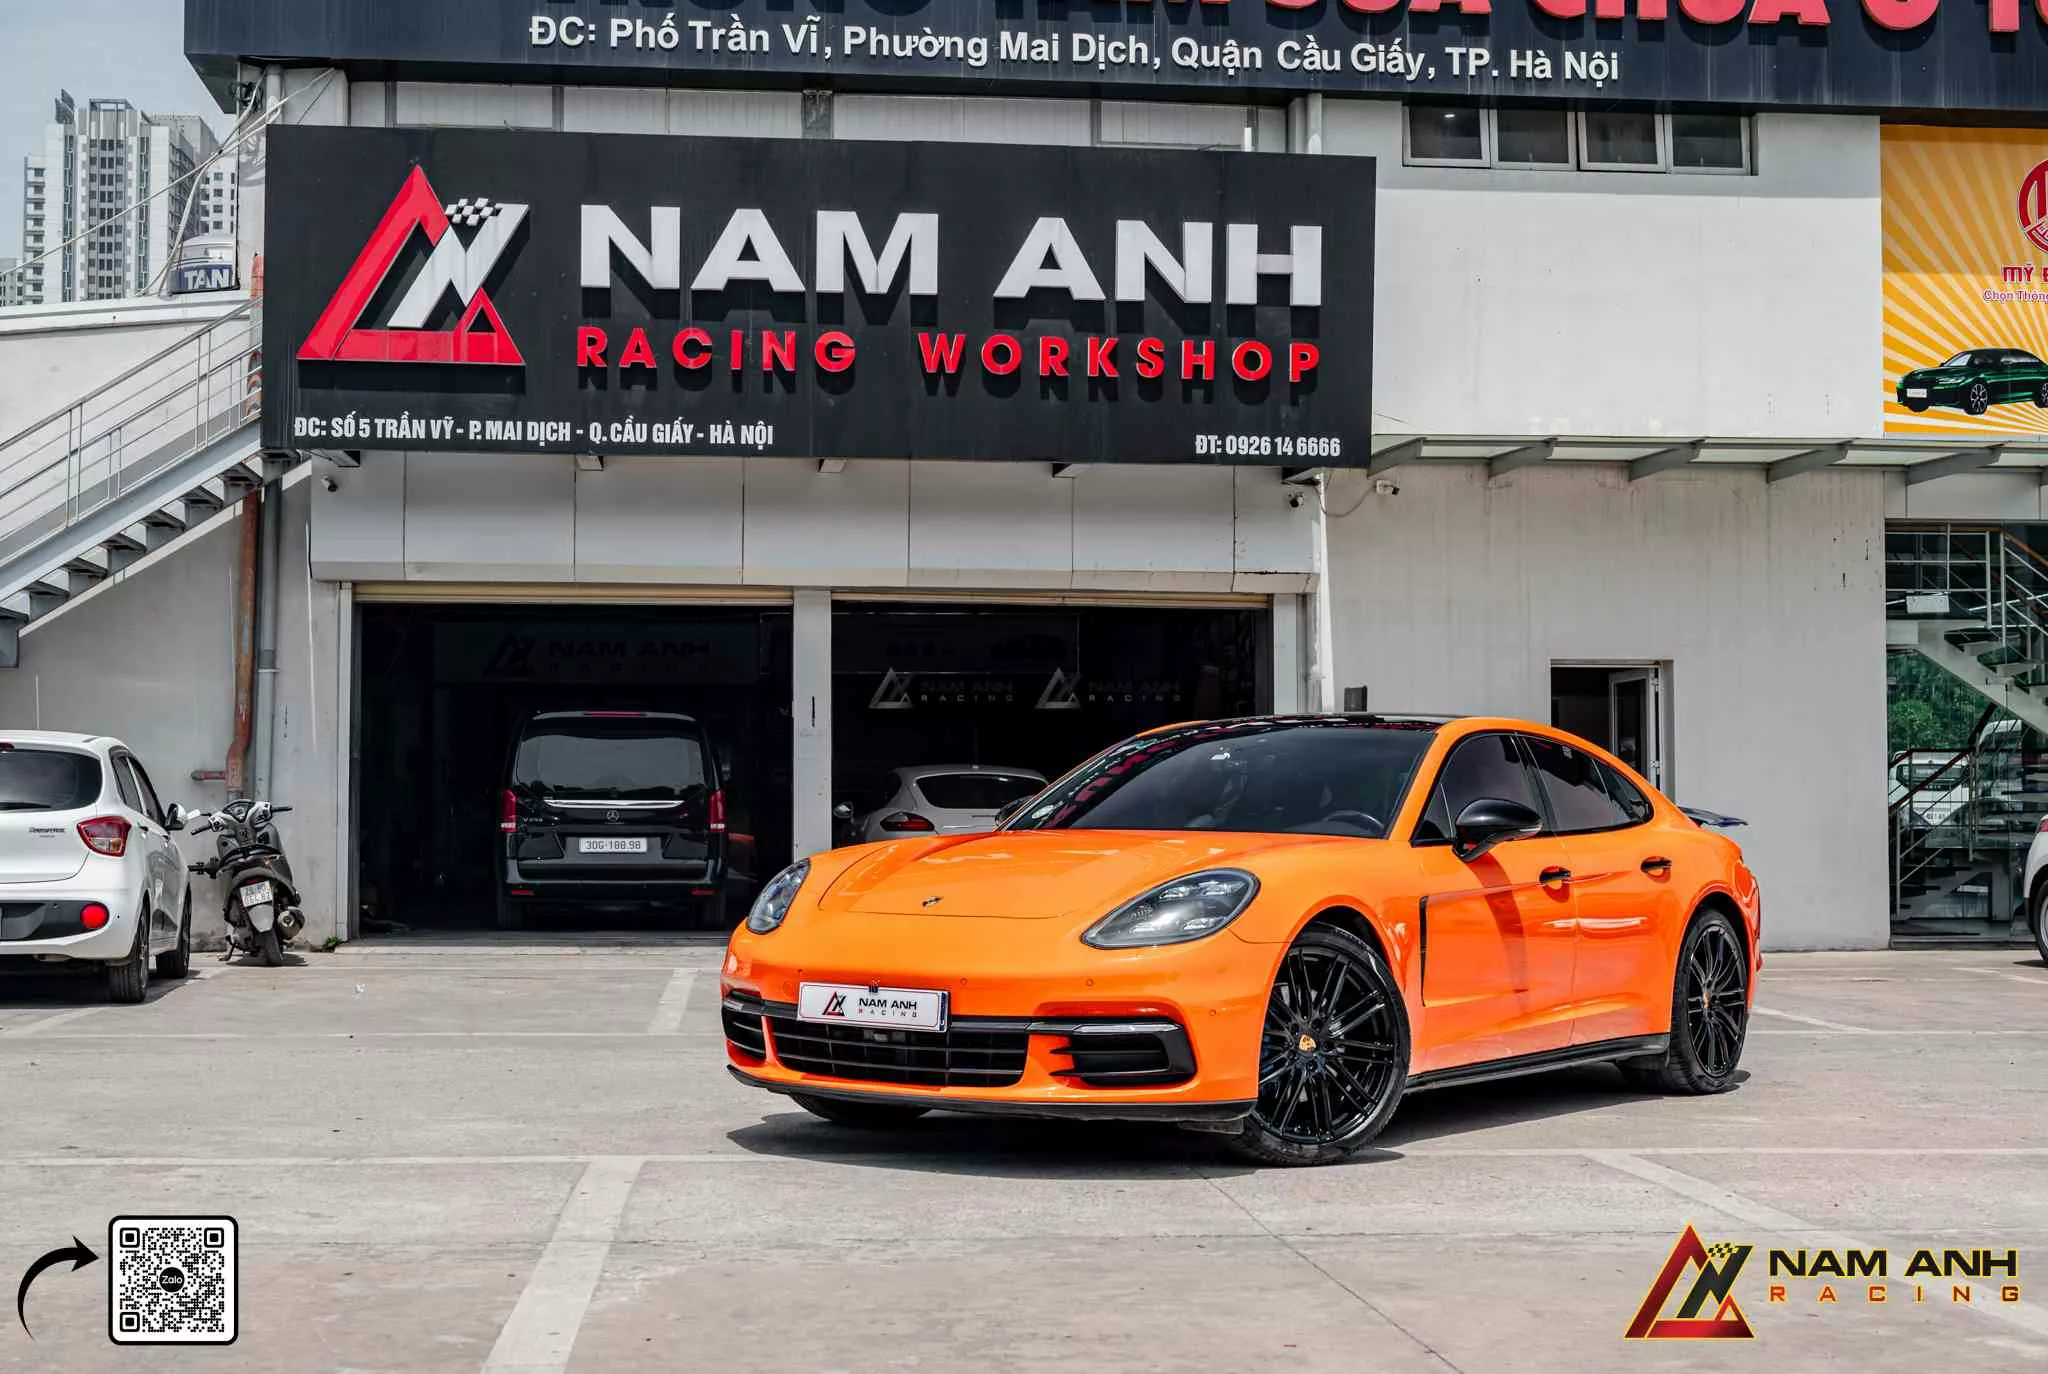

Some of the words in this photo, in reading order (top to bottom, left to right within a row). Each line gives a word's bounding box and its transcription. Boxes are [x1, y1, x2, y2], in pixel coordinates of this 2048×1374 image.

[529, 15, 596, 46] ĐC:
[610, 12, 679, 49] Phố
[687, 13, 770, 52] Trần
[844, 26, 988, 67] Phường
[1000, 31, 1059, 62] Mai
[1072, 33, 1161, 70] Dịch,
[1171, 37, 1262, 76] Quận
[1277, 35, 1341, 71] Cầu
[1350, 38, 1436, 81] Giấy,
[1445, 47, 1499, 77] TP.
[1510, 50, 1553, 79] Hà
[1564, 51, 1619, 88] Nội
[580, 204, 939, 295] NAM
[993, 217, 1323, 307] ANH
[576, 326, 857, 373] RACING
[918, 331, 1320, 383] WORKSHOP
[294, 416, 327, 437] ĐC:
[331, 410, 357, 438] SỐ
[358, 418, 371, 438] 5
[374, 411, 426, 439] TRẦN
[485, 420, 523, 441] MAI
[526, 421, 571, 447] DỊCH
[610, 414, 648, 443] CẦU
[652, 416, 694, 444] GIẤY
[709, 419, 736, 445] HÀ
[741, 420, 774, 450] NỘI
[1195, 434, 1222, 455] ĐT:
[1225, 434, 1272, 456] 0926
[1274, 436, 1294, 456] 14
[1296, 436, 1342, 457] 6666
[859, 997, 887, 1008] NAM
[891, 999, 917, 1010] ANH
